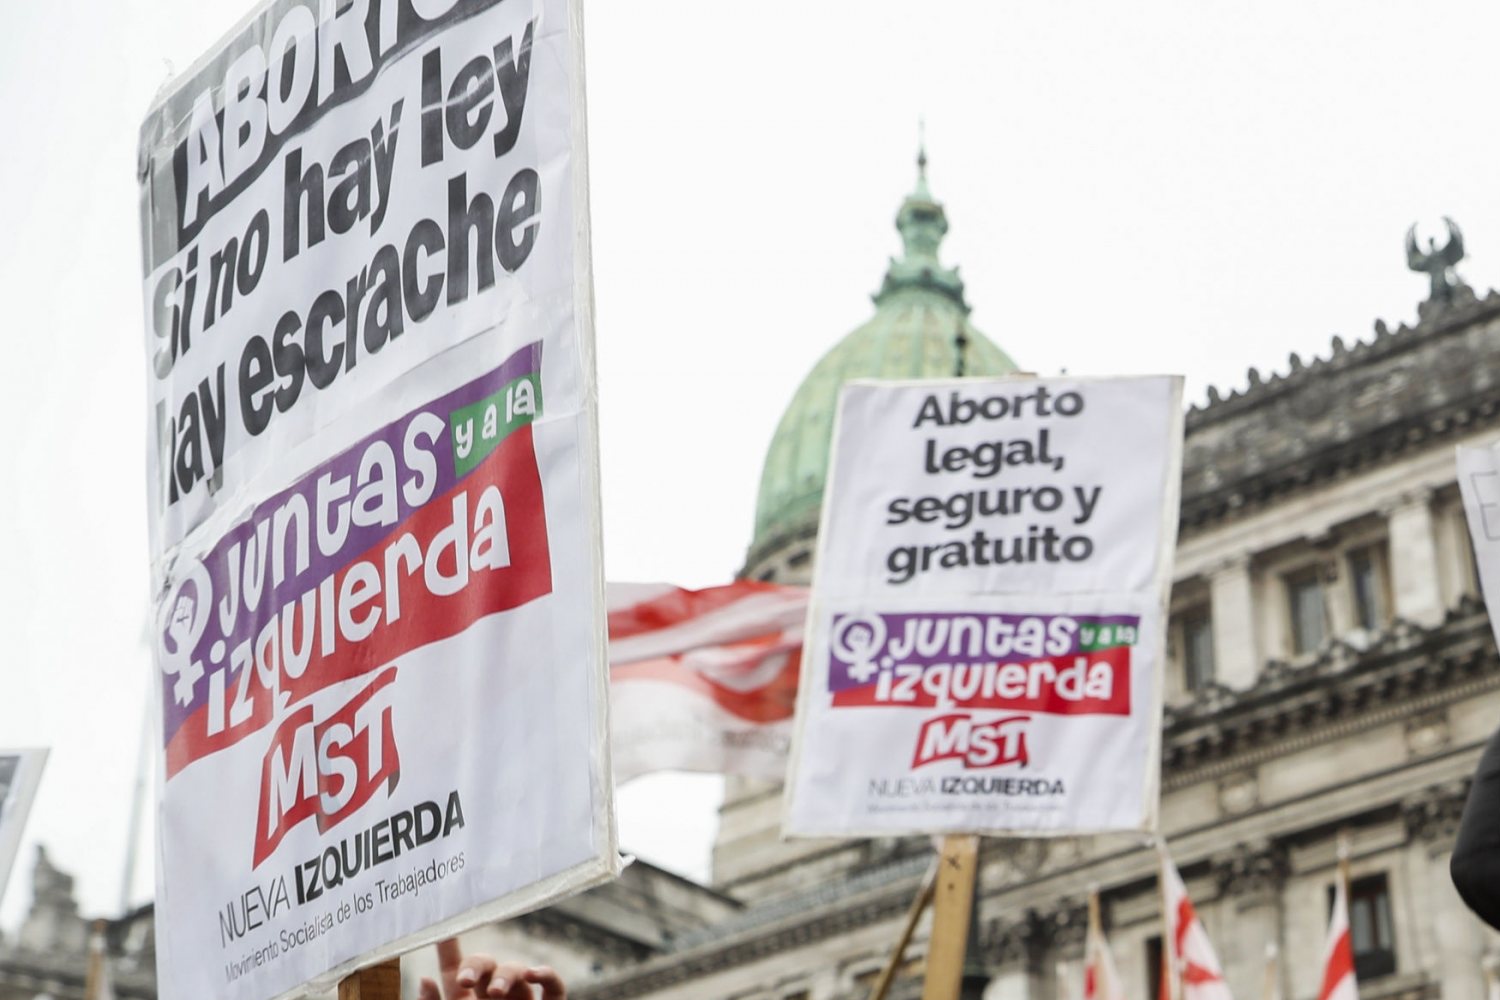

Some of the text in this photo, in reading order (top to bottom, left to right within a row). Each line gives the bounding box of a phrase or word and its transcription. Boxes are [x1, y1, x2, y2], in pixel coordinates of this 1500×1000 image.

[202, 207, 271, 333] no
[282, 96, 405, 264] hay
[420, 16, 538, 168] ley
[237, 166, 542, 437] escrache
[454, 420, 476, 459] y
[481, 403, 498, 440] a
[506, 377, 536, 423] la
[912, 385, 1086, 429] Aborto
[924, 428, 1065, 478] legal,
[885, 484, 1103, 530] seguro y
[886, 525, 1094, 585] gratuito
[264, 682, 396, 846] MST
[916, 718, 1028, 767] MST
[940, 776, 1065, 797] IZQUIERDA
[218, 791, 466, 949] NUEVA IZQUIERDA
[224, 942, 280, 984] Movimiento
[336, 900, 352, 925] de
[353, 893, 374, 916] los
[375, 850, 466, 906] Trabajadores
